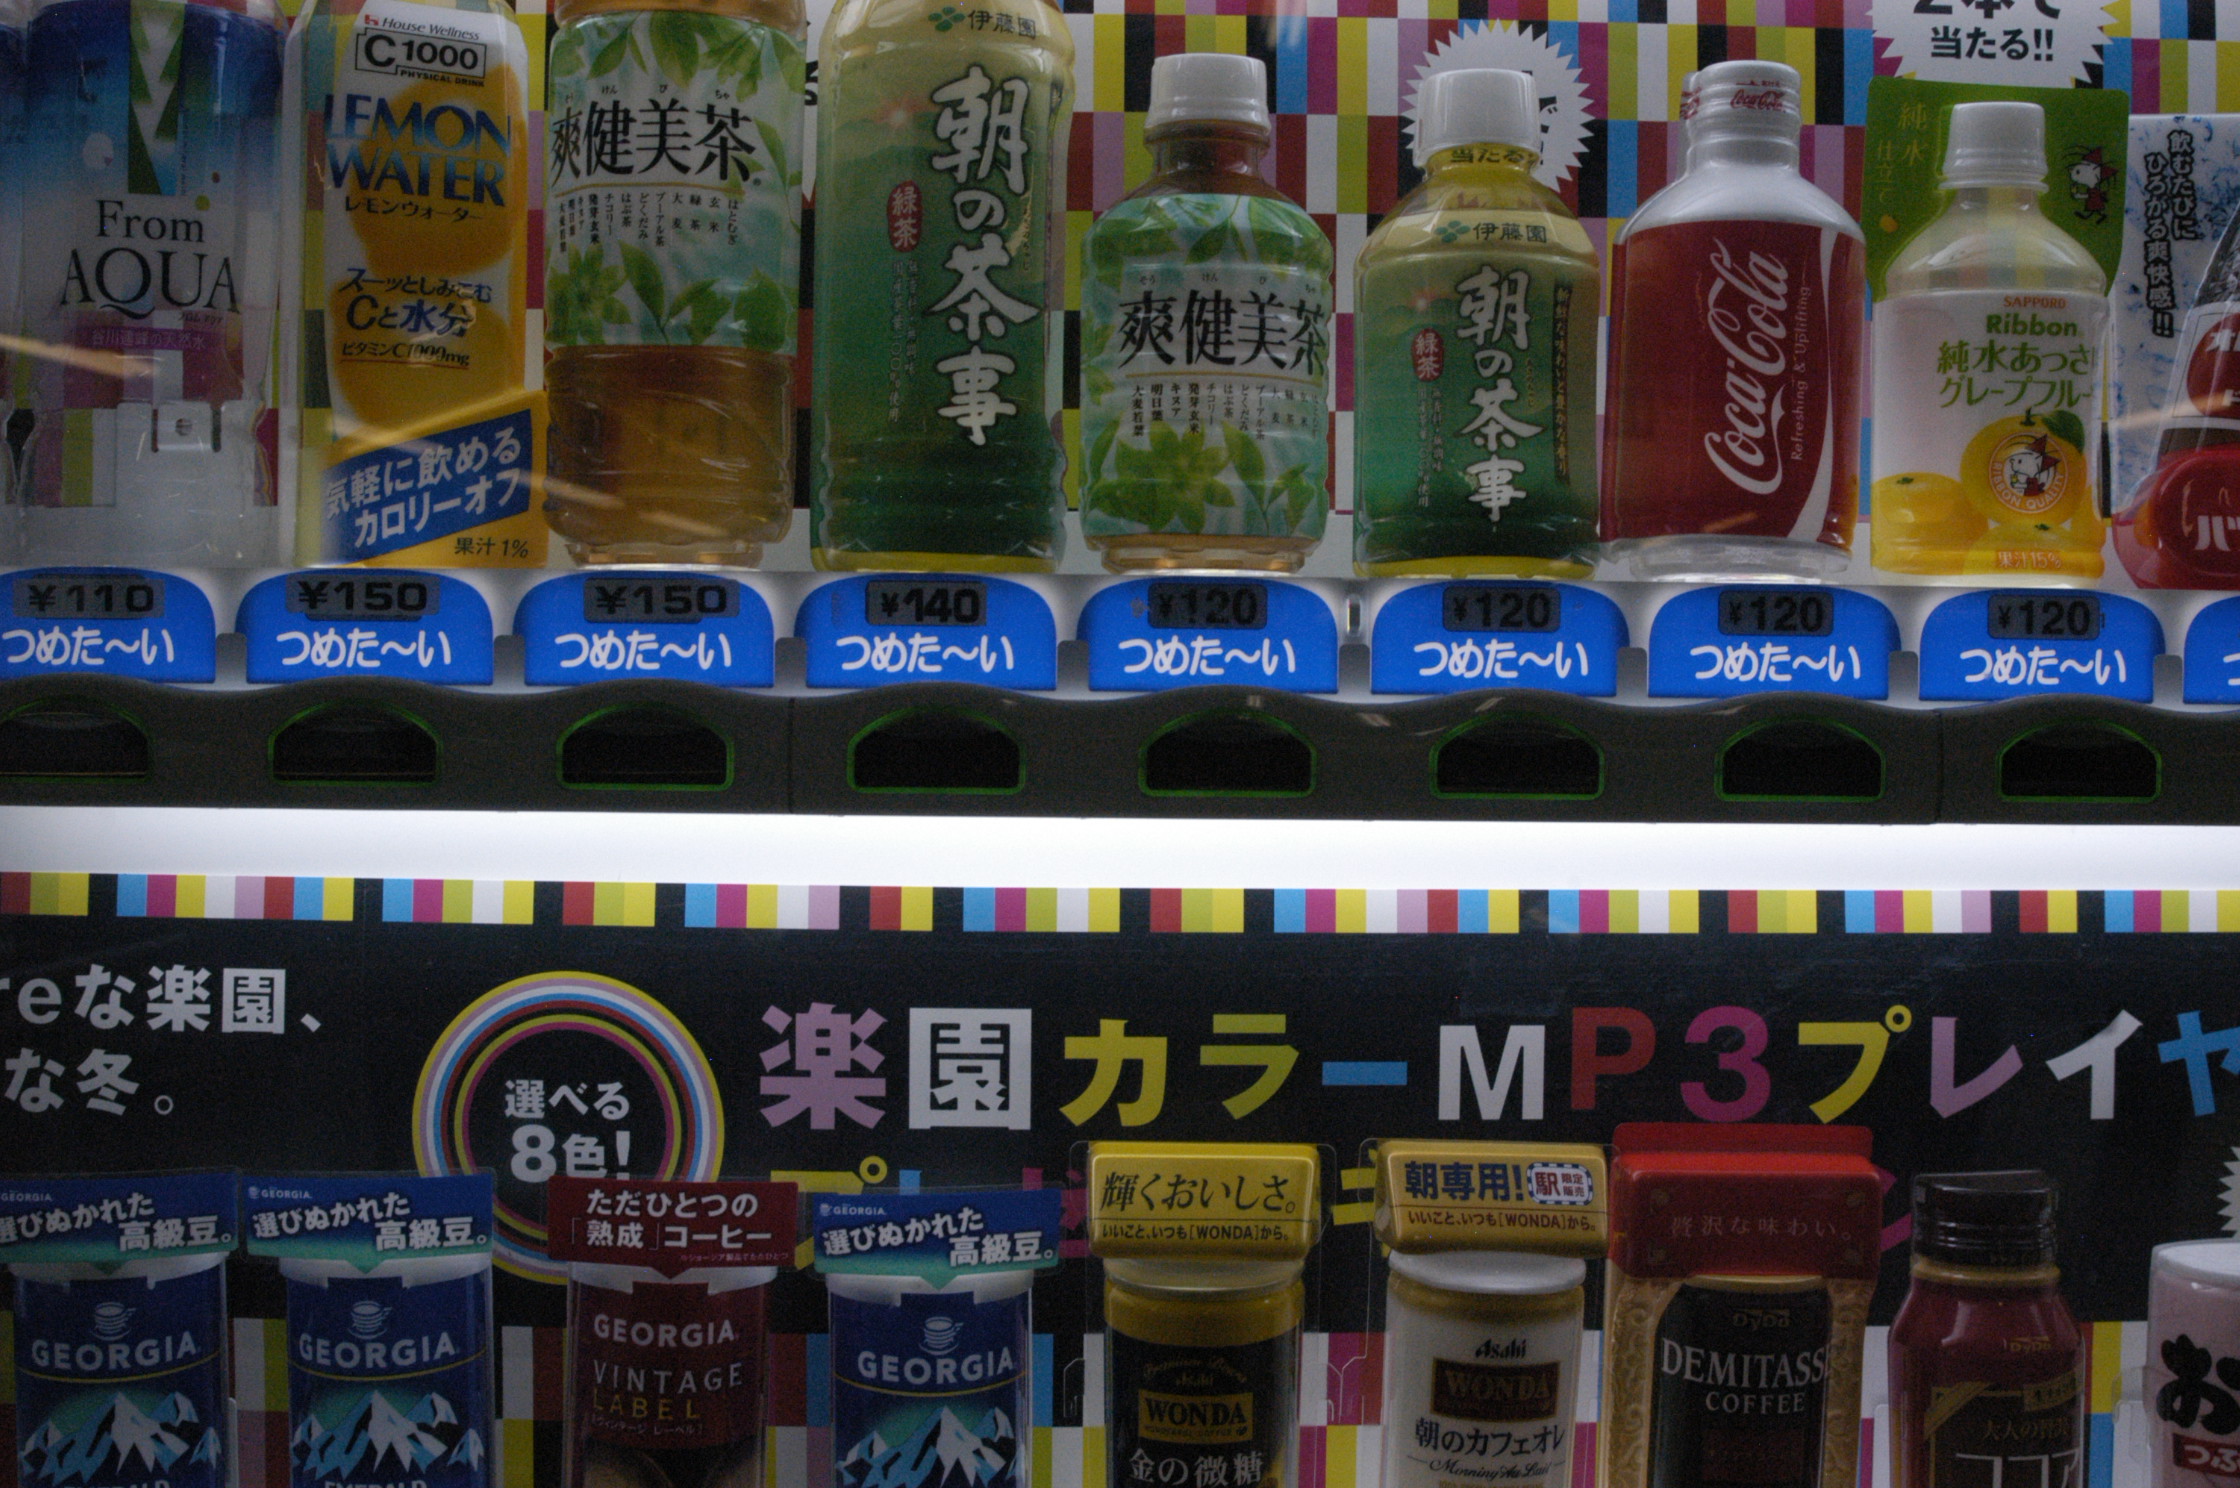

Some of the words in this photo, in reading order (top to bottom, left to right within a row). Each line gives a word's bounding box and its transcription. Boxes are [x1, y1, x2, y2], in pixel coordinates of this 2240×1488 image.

[382, 17, 426, 33] House
[429, 24, 481, 41] Wellness
[968, 10, 1036, 39] 伊藤園
[364, 34, 479, 70] C1000
[1930, 27, 2054, 62] 当たる!!
[401, 70, 452, 83] PHYSICAL
[454, 78, 485, 87] DRINK
[324, 94, 512, 159] LEMON
[551, 97, 757, 187] 爽健美茶
[326, 142, 505, 207] WATER
[2168, 130, 2198, 240] 飲むたびに
[97, 199, 204, 242] From
[345, 197, 484, 222] レモンウォーター
[891, 185, 918, 249] 緑茶
[1473, 221, 1547, 243] 伊藤園
[927, 65, 1041, 445] 朝の茶事
[58, 247, 240, 319] AQUA
[339, 268, 492, 303] スーッとしみこむ
[346, 294, 478, 336] Cと水分
[1118, 290, 1327, 376] 爽健美茶
[1795, 285, 1811, 357] Uplifting
[1986, 314, 2078, 337] Ribbon
[1415, 333, 1440, 379] 緑茶
[1704, 237, 1789, 495] Coca-Cola
[1794, 358, 1806, 374] &
[1456, 265, 1546, 522] 朝の茶事
[1791, 380, 1809, 461] Refreshing
[324, 427, 521, 519] 気軽に飲める
[354, 468, 521, 549] カロリーオフ
[29, 584, 154, 613] ¥110
[299, 580, 428, 611] ¥150
[596, 585, 727, 615] ¥150
[880, 588, 981, 623] ¥140
[1157, 588, 1258, 625] ¥120
[1453, 591, 1552, 628] ¥120
[1728, 596, 1825, 632] ¥120
[1999, 600, 2091, 635] ¥120
[4, 1047, 174, 1116] な冬。
[504, 1079, 630, 1121] 選べる
[510, 1124, 631, 1183] 8色!
[260, 1188, 312, 1199] GEORGIA
[1101, 1172, 1296, 1214] 輝くおいしさ。
[1404, 1162, 1525, 1201] 朝専用!
[1535, 1171, 1561, 1197] 駅
[253, 1192, 412, 1239] 選びぬかれた
[586, 1188, 759, 1218] ただひとつの
[833, 1205, 885, 1216] GEORGIA
[118, 1215, 233, 1252] 高級豆。
[375, 1216, 488, 1252] 高級豆。
[571, 1217, 773, 1250] 「熟成」コーヒー
[823, 1206, 984, 1256] 選びぬかれた
[949, 1231, 1054, 1267] 高級豆。
[594, 1314, 735, 1348] GEORGIA
[1475, 1339, 1527, 1360] Asahi
[31, 1331, 197, 1371] GEORGIA
[299, 1331, 456, 1369] GEORGIA
[858, 1346, 1014, 1386] GEORGIA
[594, 1359, 743, 1395] VINTAGE
[594, 1387, 701, 1420] LABEL
[1145, 1397, 1248, 1427] WONDA
[1705, 1390, 1806, 1416] COFFEE
[1415, 1417, 1566, 1457] 朝のカフェオレ
[1129, 1447, 1264, 1488] 金の微糖
[1430, 1459, 1501, 1482] Morning
